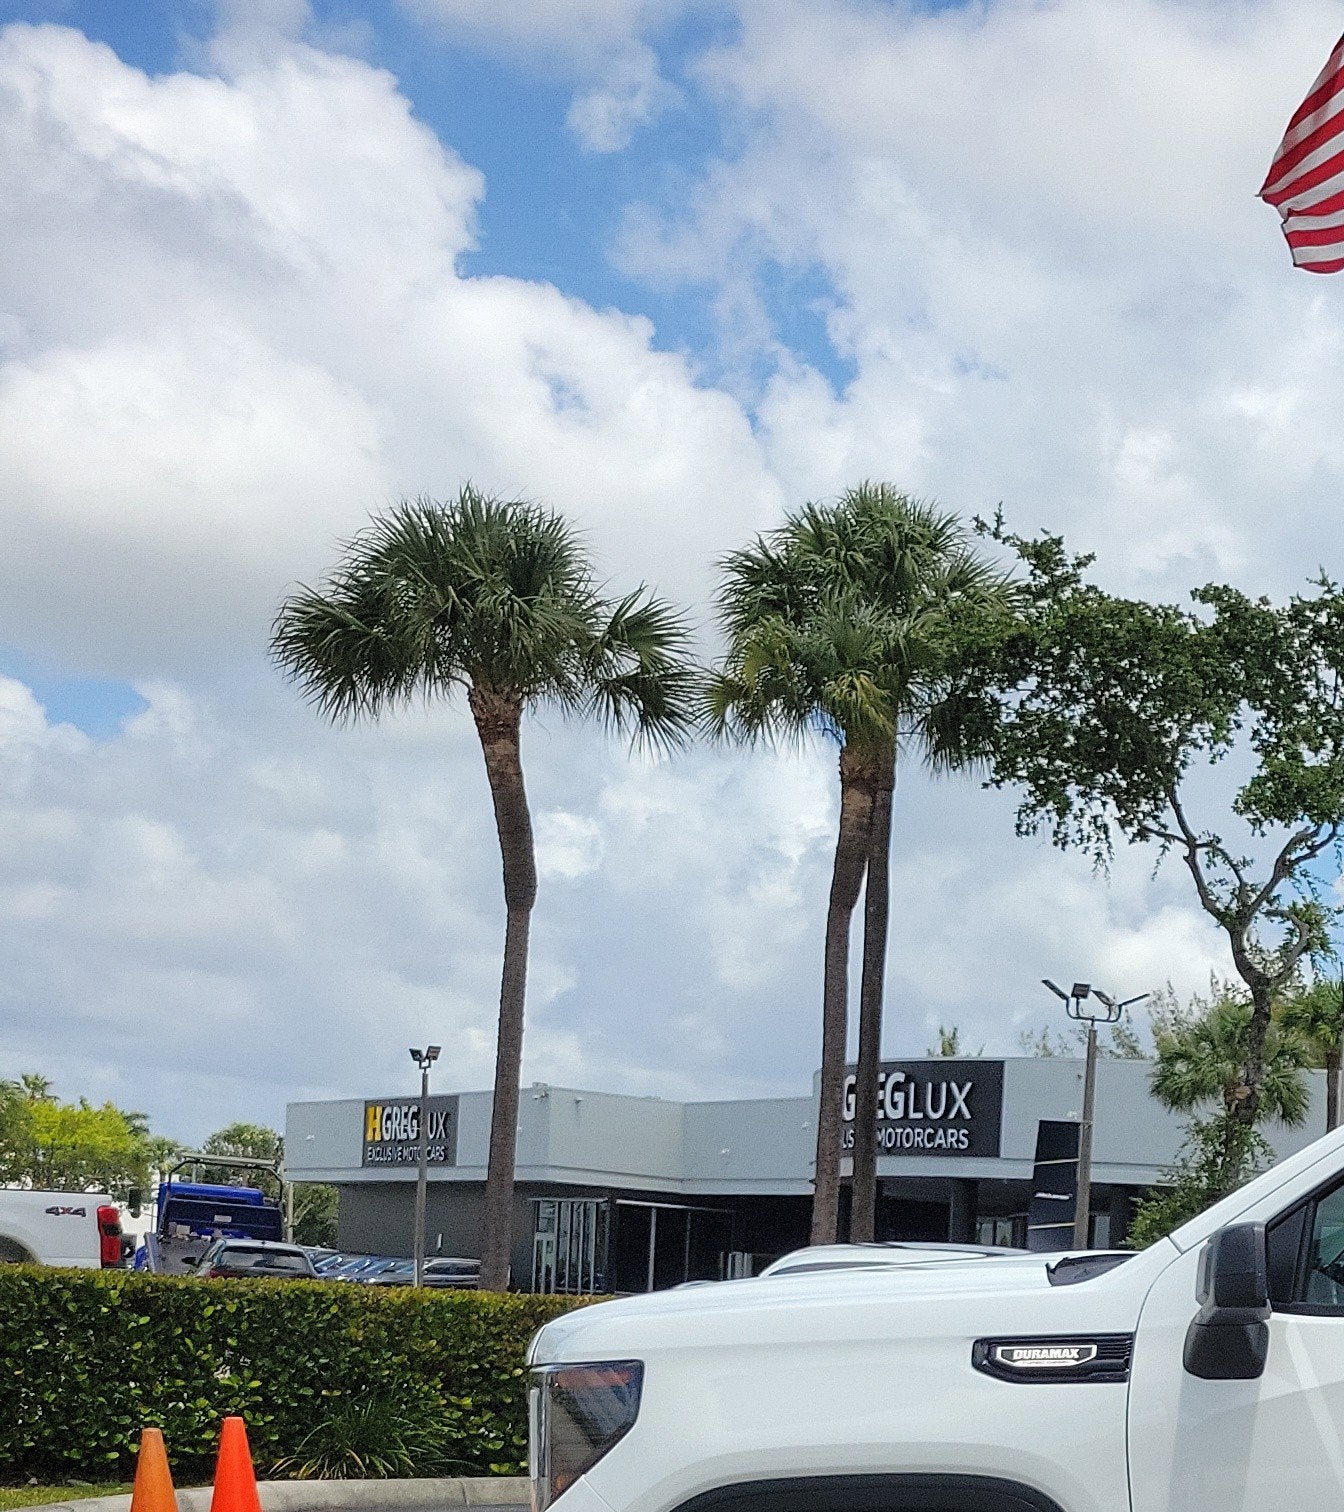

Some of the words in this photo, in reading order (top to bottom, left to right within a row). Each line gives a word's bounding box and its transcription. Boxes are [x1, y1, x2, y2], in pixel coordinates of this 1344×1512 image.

[842, 1072, 973, 1121] GEGLUX
[366, 1104, 447, 1142] HGREGUX
[877, 1127, 969, 1149] MOTORCARS
[402, 1145, 445, 1161] MOTOCARS
[1013, 1348, 1080, 1360] DURAMAX
